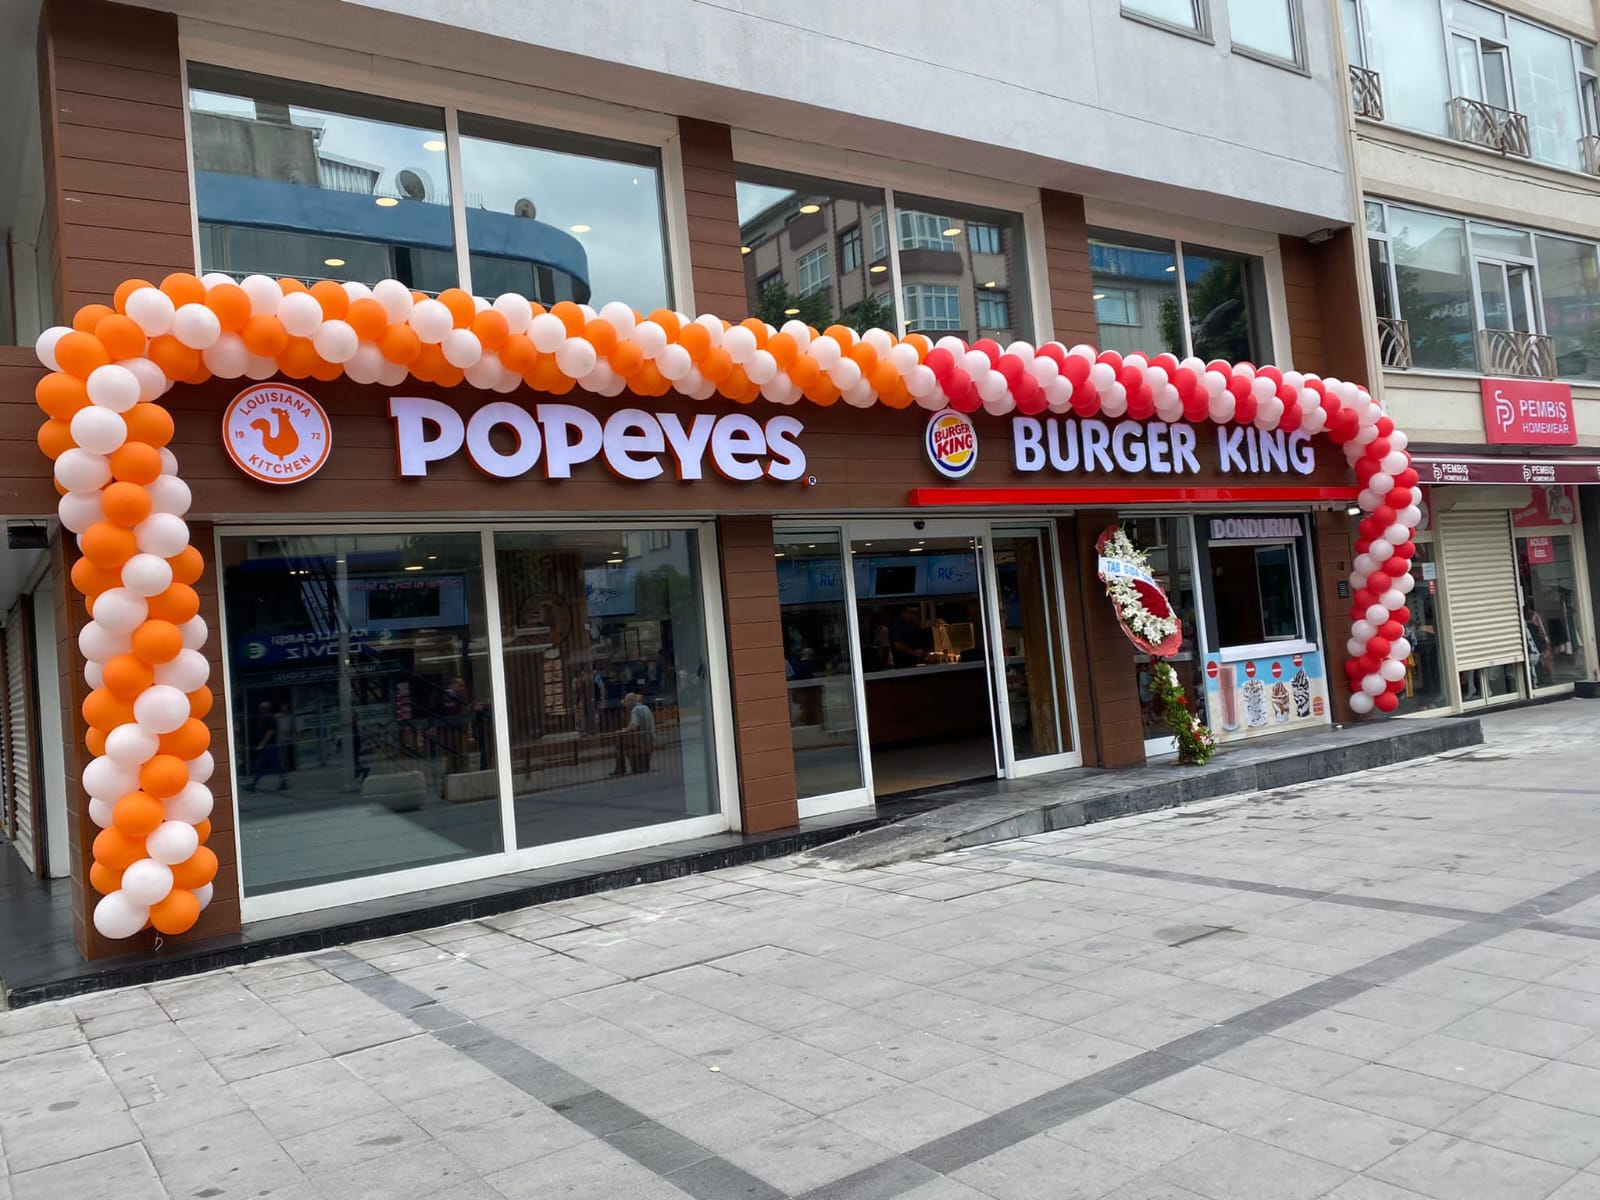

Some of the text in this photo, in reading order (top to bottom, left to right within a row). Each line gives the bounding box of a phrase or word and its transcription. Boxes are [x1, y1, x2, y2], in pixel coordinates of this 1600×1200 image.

[239, 392, 312, 418] LOUISIANA
[235, 430, 245, 439] 19
[311, 432, 321, 441] 72
[934, 423, 971, 444] BURGER
[1523, 422, 1569, 434] HOMEWEAR
[937, 433, 973, 460] KING
[1013, 416, 1315, 475] BURGER KING
[248, 454, 312, 474] KITCHEN
[1210, 518, 1303, 539] DONDURMA
[1107, 560, 1120, 573] TAB
